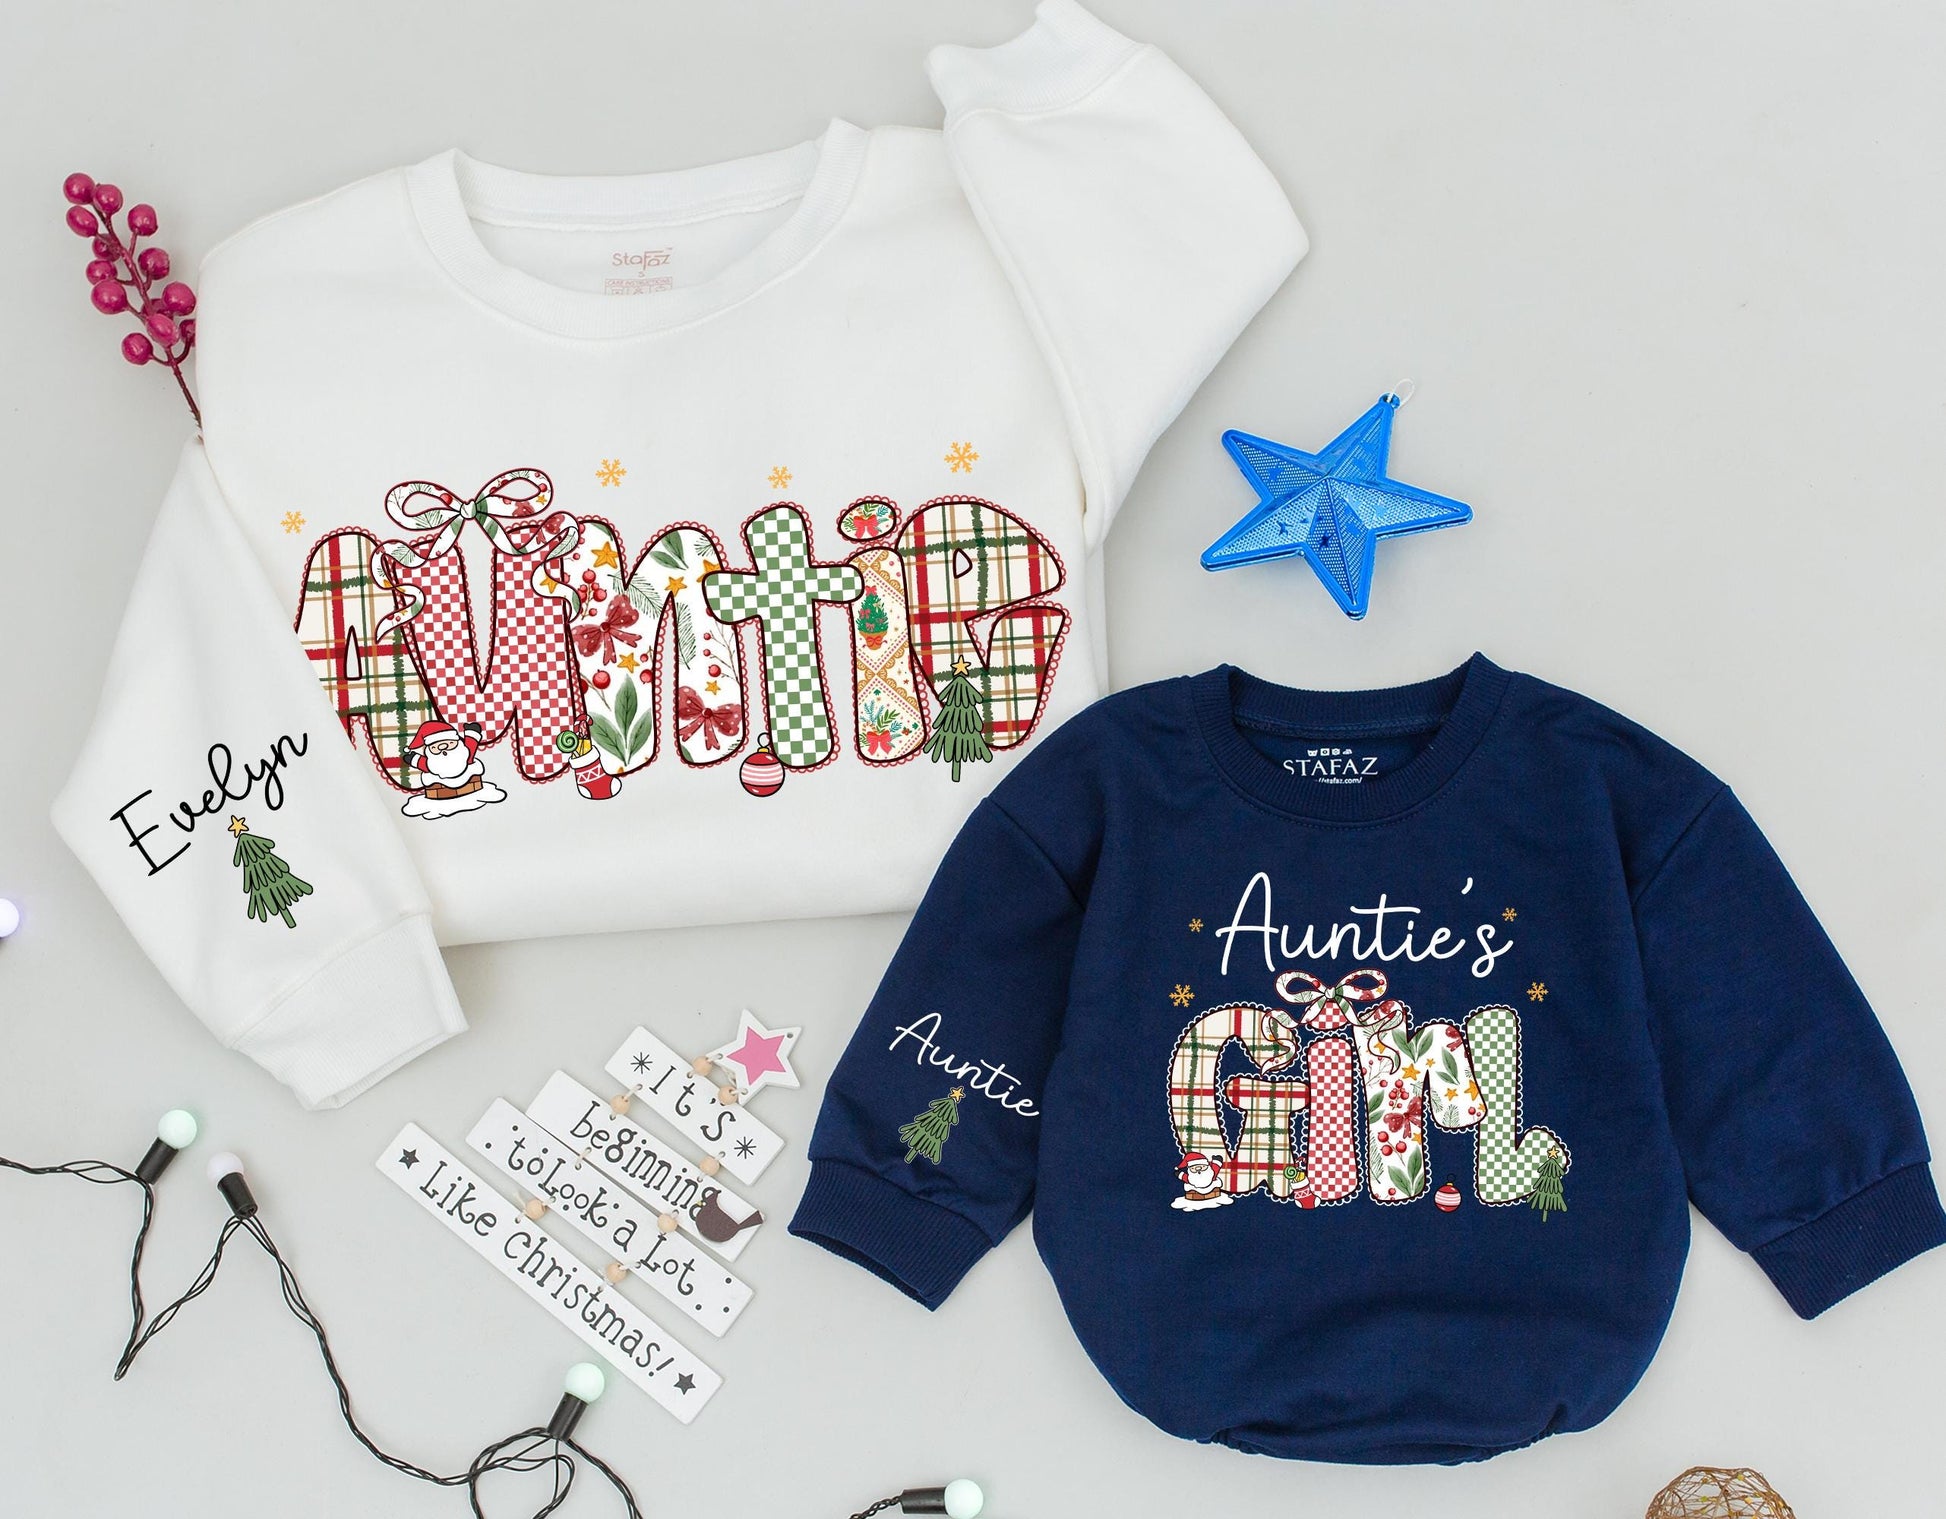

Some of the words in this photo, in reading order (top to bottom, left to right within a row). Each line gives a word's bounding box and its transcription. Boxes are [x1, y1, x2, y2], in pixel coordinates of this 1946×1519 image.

[109, 732, 308, 877] Evelyn
[1283, 757, 1378, 776] STAFAZ
[1214, 871, 1514, 978] Auntie's
[888, 1012, 1040, 1117] Auntie
[419, 1160, 498, 1237] Like
[538, 1157, 609, 1228] Look
[613, 1218, 638, 1252] a
[640, 1233, 695, 1296] Lot
